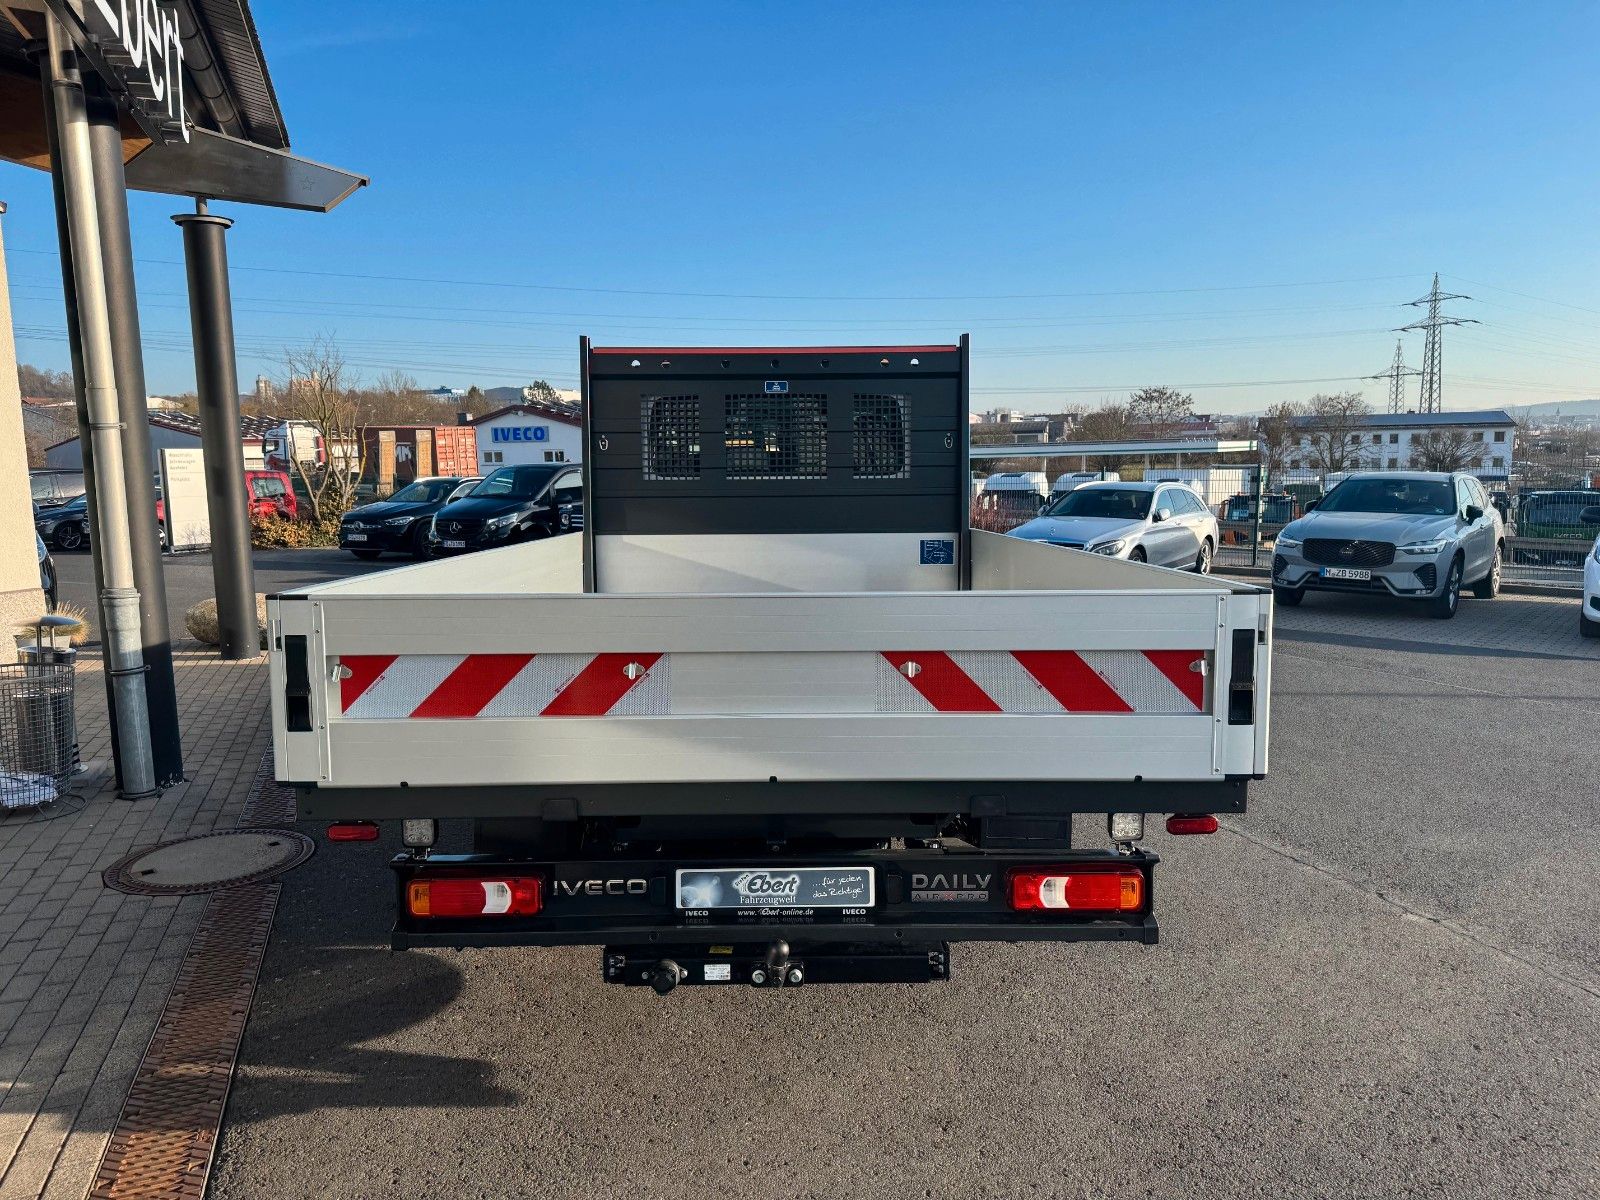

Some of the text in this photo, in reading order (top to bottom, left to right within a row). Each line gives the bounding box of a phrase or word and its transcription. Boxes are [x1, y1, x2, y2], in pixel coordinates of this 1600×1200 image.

[493, 427, 545, 441] IVECO
[553, 879, 647, 896] IVECO
[747, 874, 797, 894] Ebert
[912, 874, 991, 888] DAILY
[740, 895, 797, 905] Fahrzeugwelt
